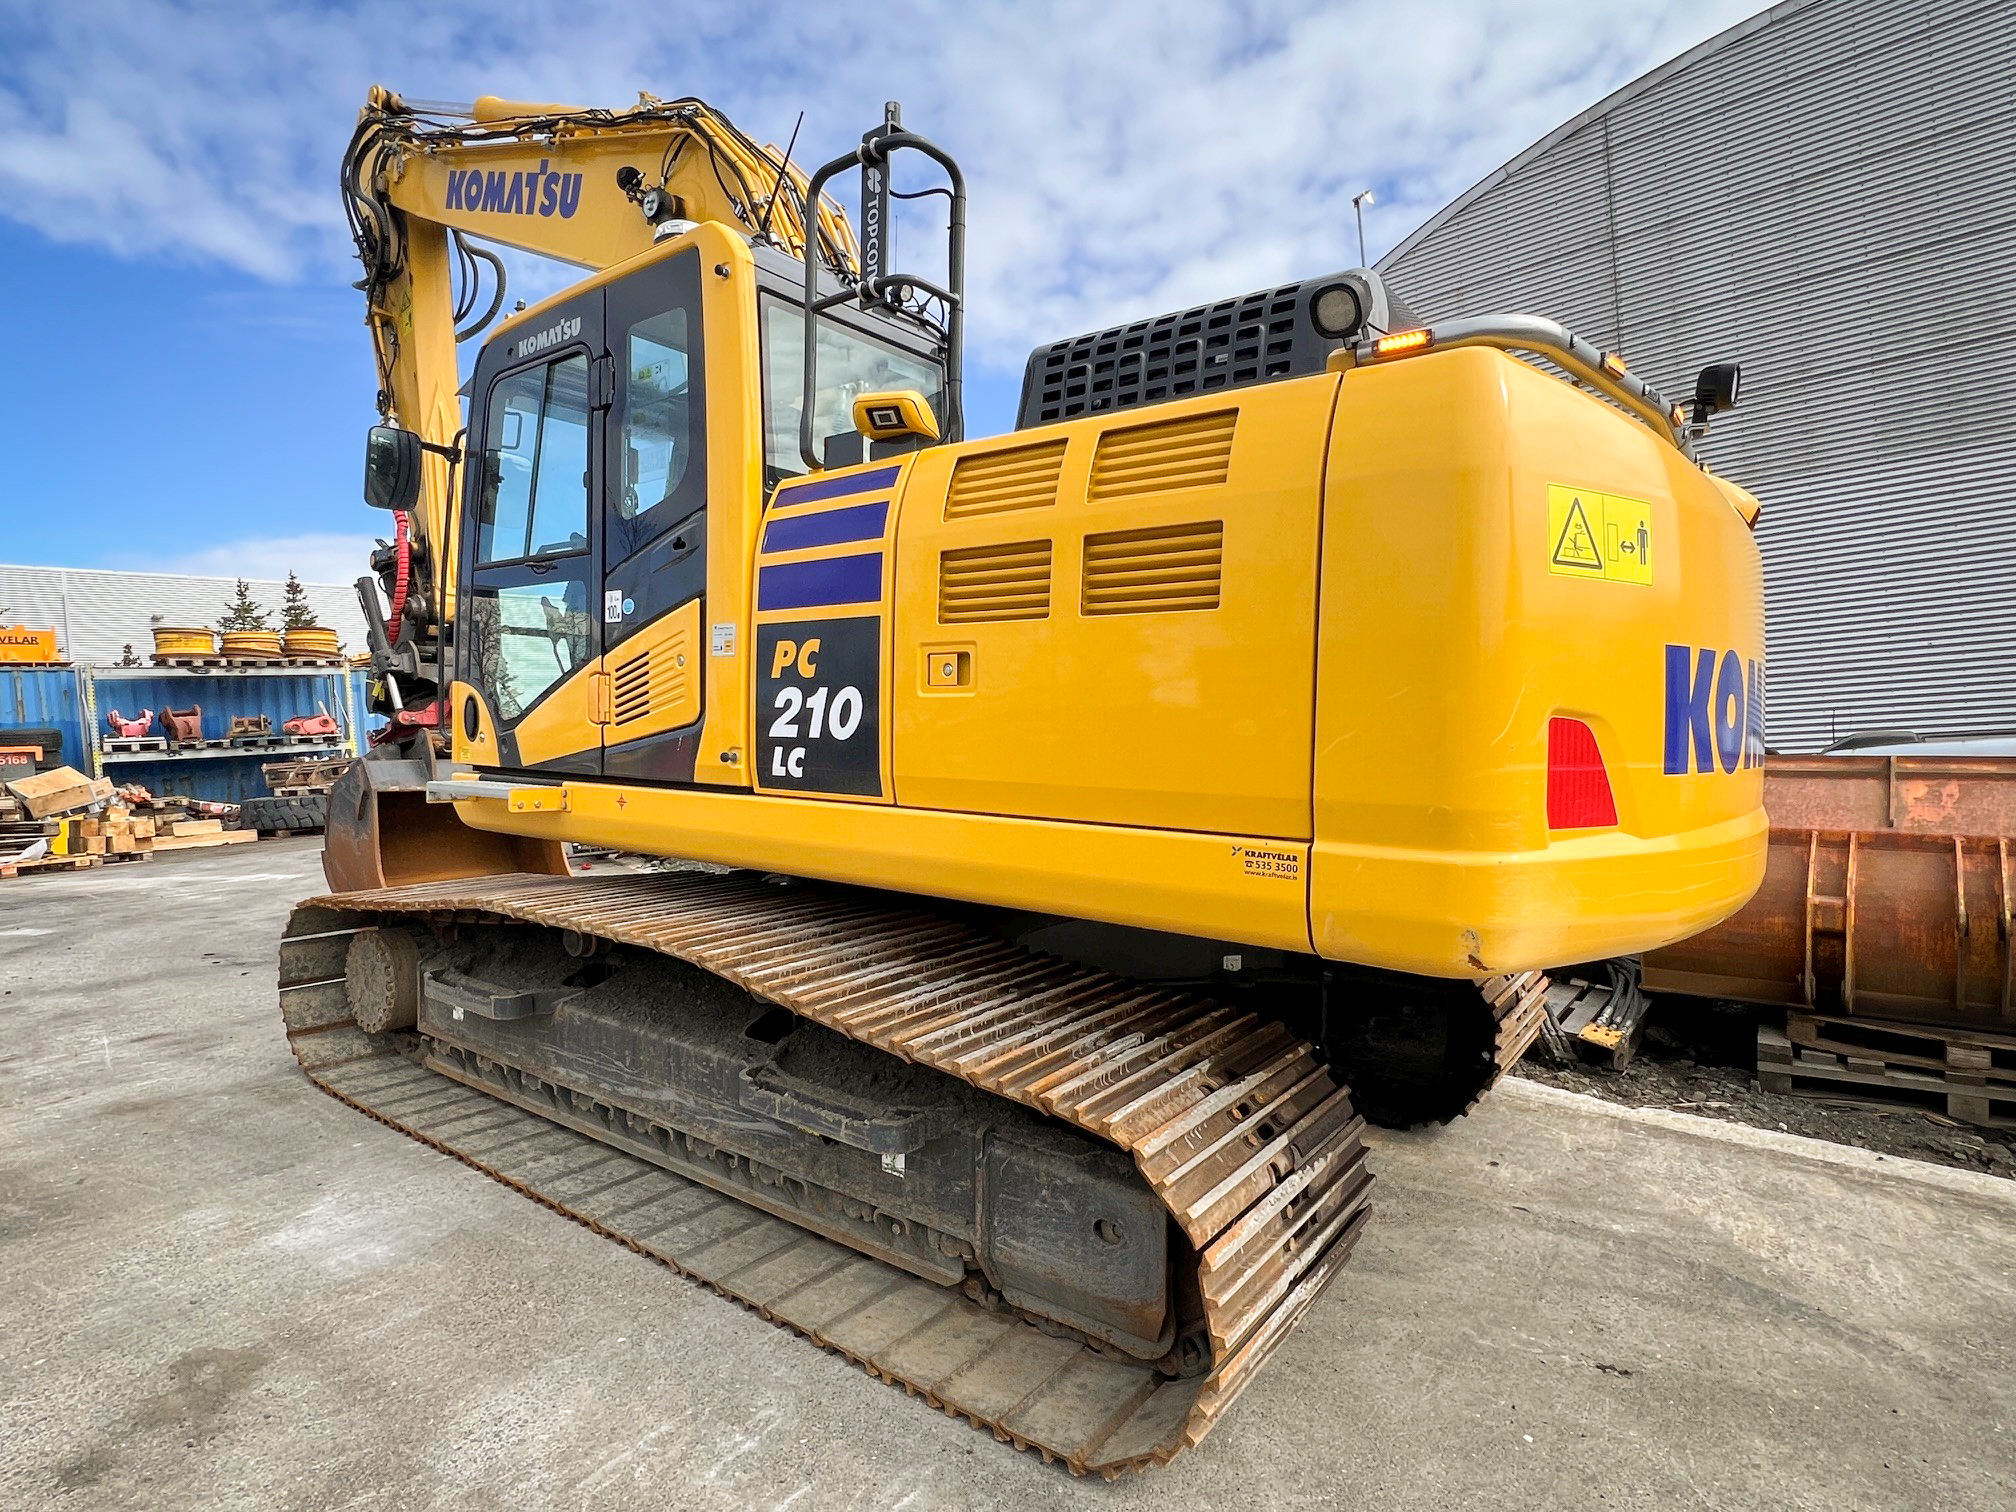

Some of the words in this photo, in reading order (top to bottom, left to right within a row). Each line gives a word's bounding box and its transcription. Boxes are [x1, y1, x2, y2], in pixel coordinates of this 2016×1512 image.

[446, 159, 583, 219] KOMATSU
[866, 193, 879, 282] TOPCON
[518, 316, 582, 358] KOMATSU
[771, 638, 821, 679] PC
[768, 685, 863, 741] 210
[772, 746, 806, 778] LC
[1255, 860, 1272, 870] 535
[1274, 862, 1298, 873] 3500
